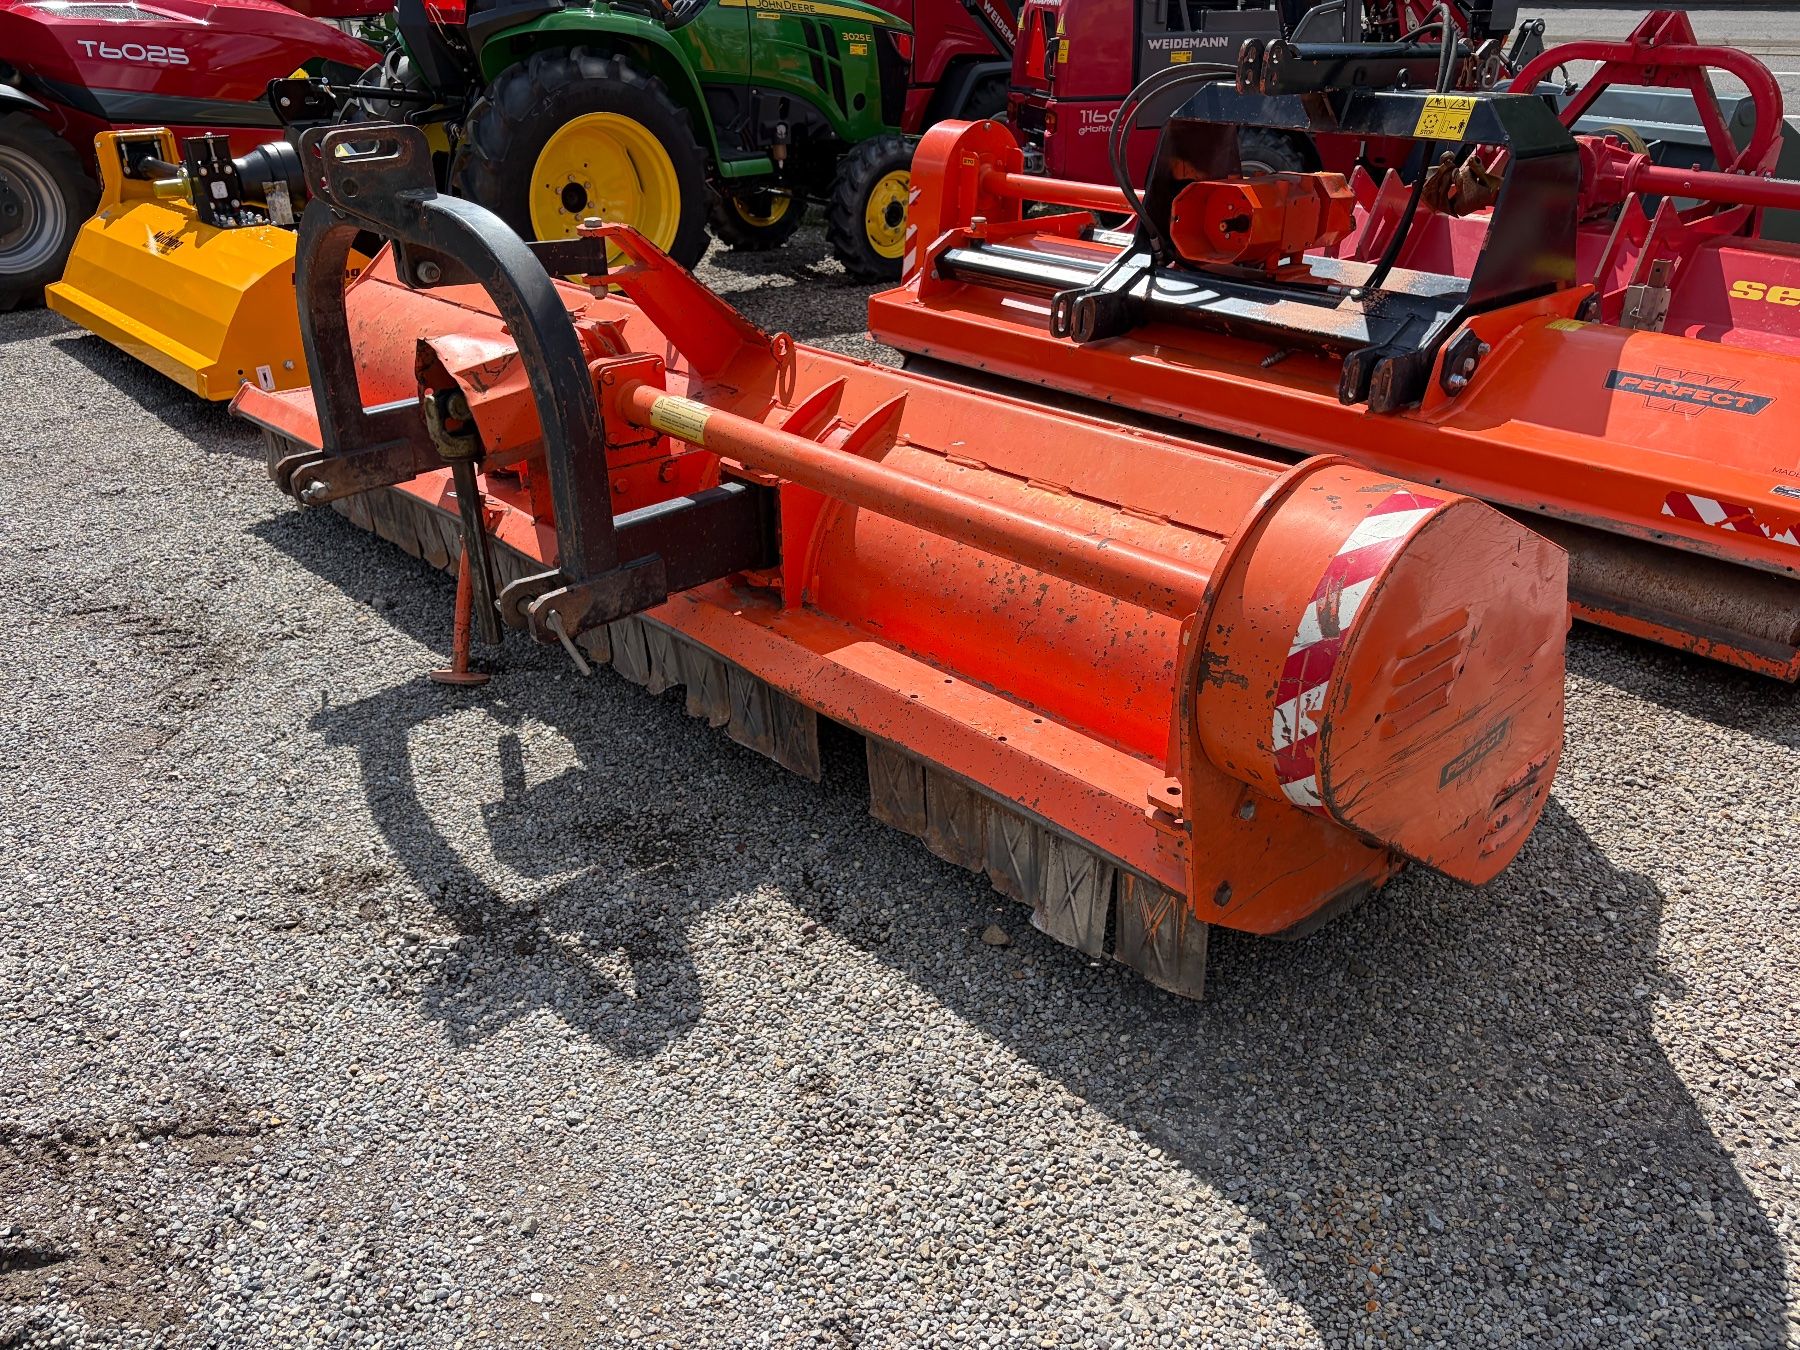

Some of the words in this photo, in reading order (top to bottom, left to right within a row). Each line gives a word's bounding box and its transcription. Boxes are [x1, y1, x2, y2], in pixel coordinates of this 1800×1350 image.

[756, 0, 784, 10] JOHN
[784, 1, 816, 13] DEERE
[983, 1, 1016, 46] WEIDEMA
[77, 40, 189, 65] T6025
[1148, 36, 1229, 50] WEIDEMANN
[1618, 376, 1754, 408] PERFECT
[1445, 726, 1504, 780] PERFECT
